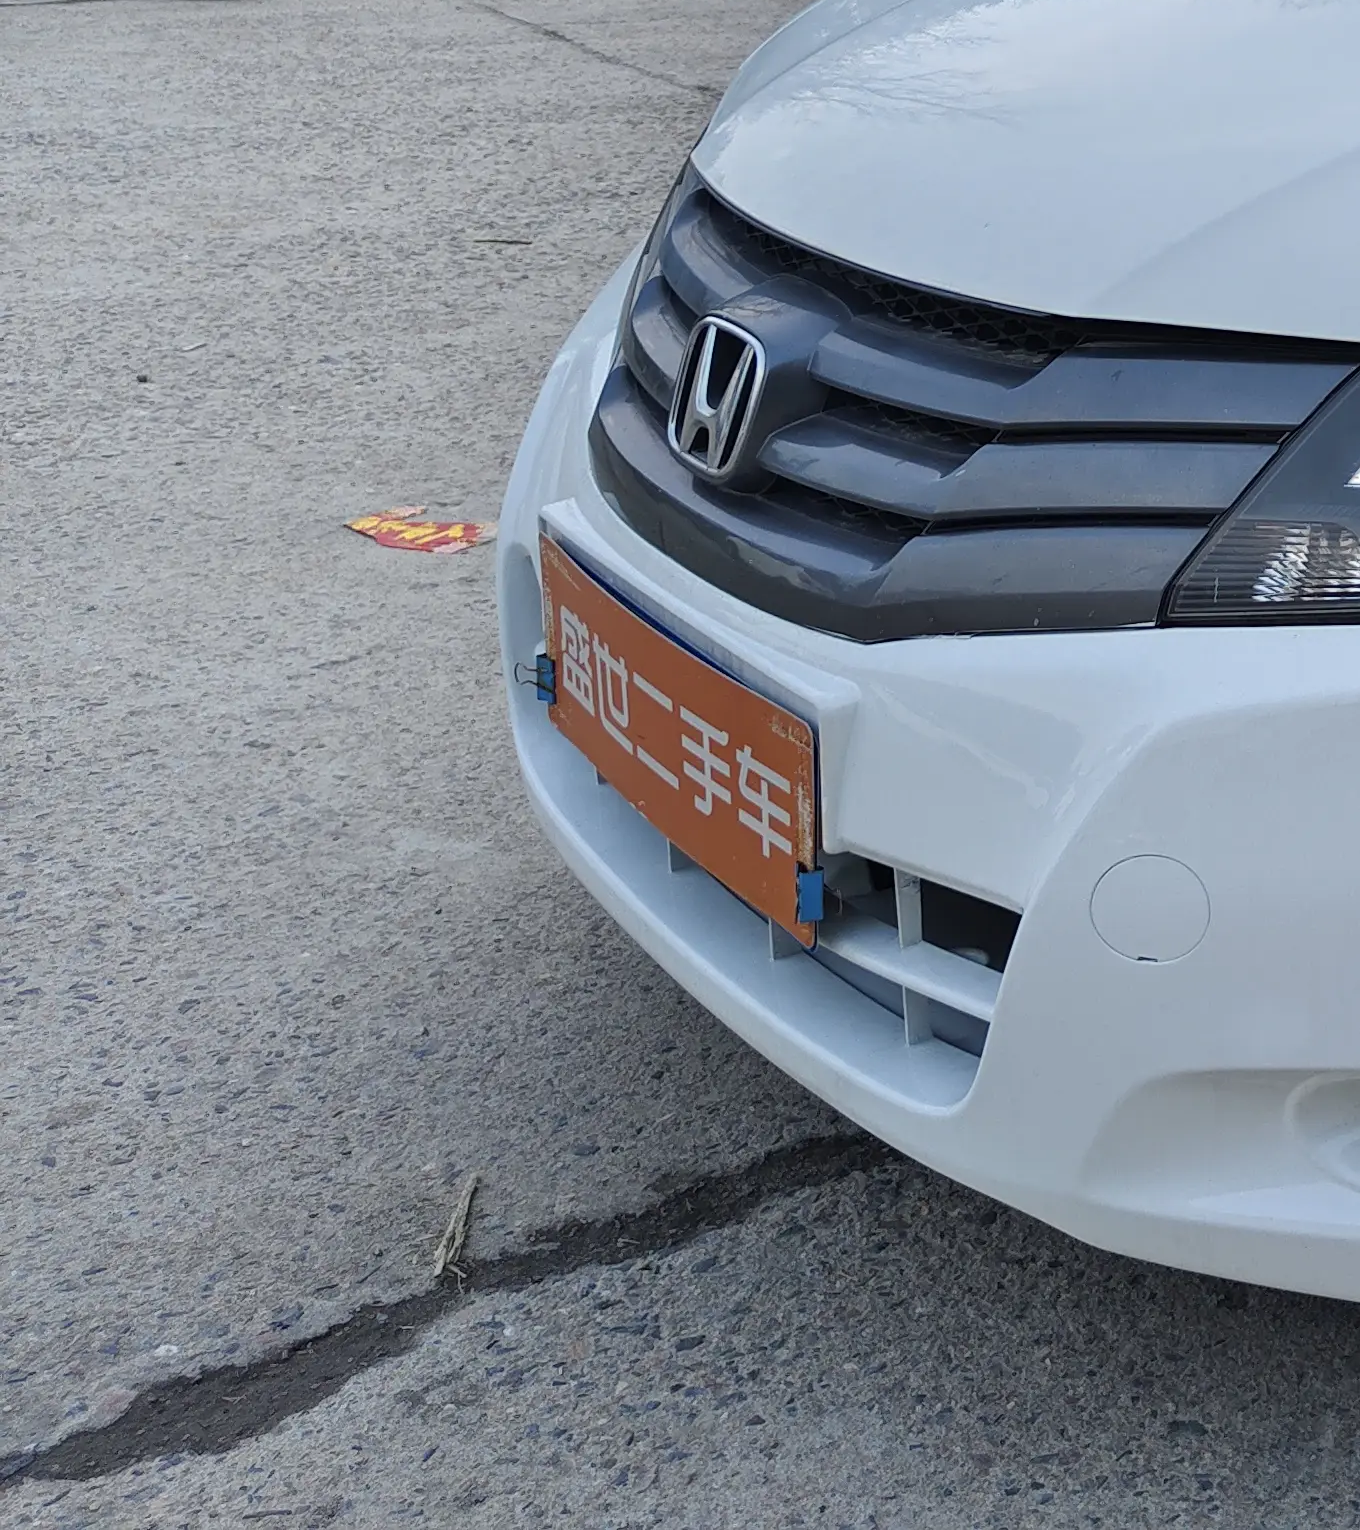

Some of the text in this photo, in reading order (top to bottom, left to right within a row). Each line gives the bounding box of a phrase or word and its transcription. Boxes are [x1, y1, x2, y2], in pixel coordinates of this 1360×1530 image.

[559, 604, 793, 859] 盛世二手车
